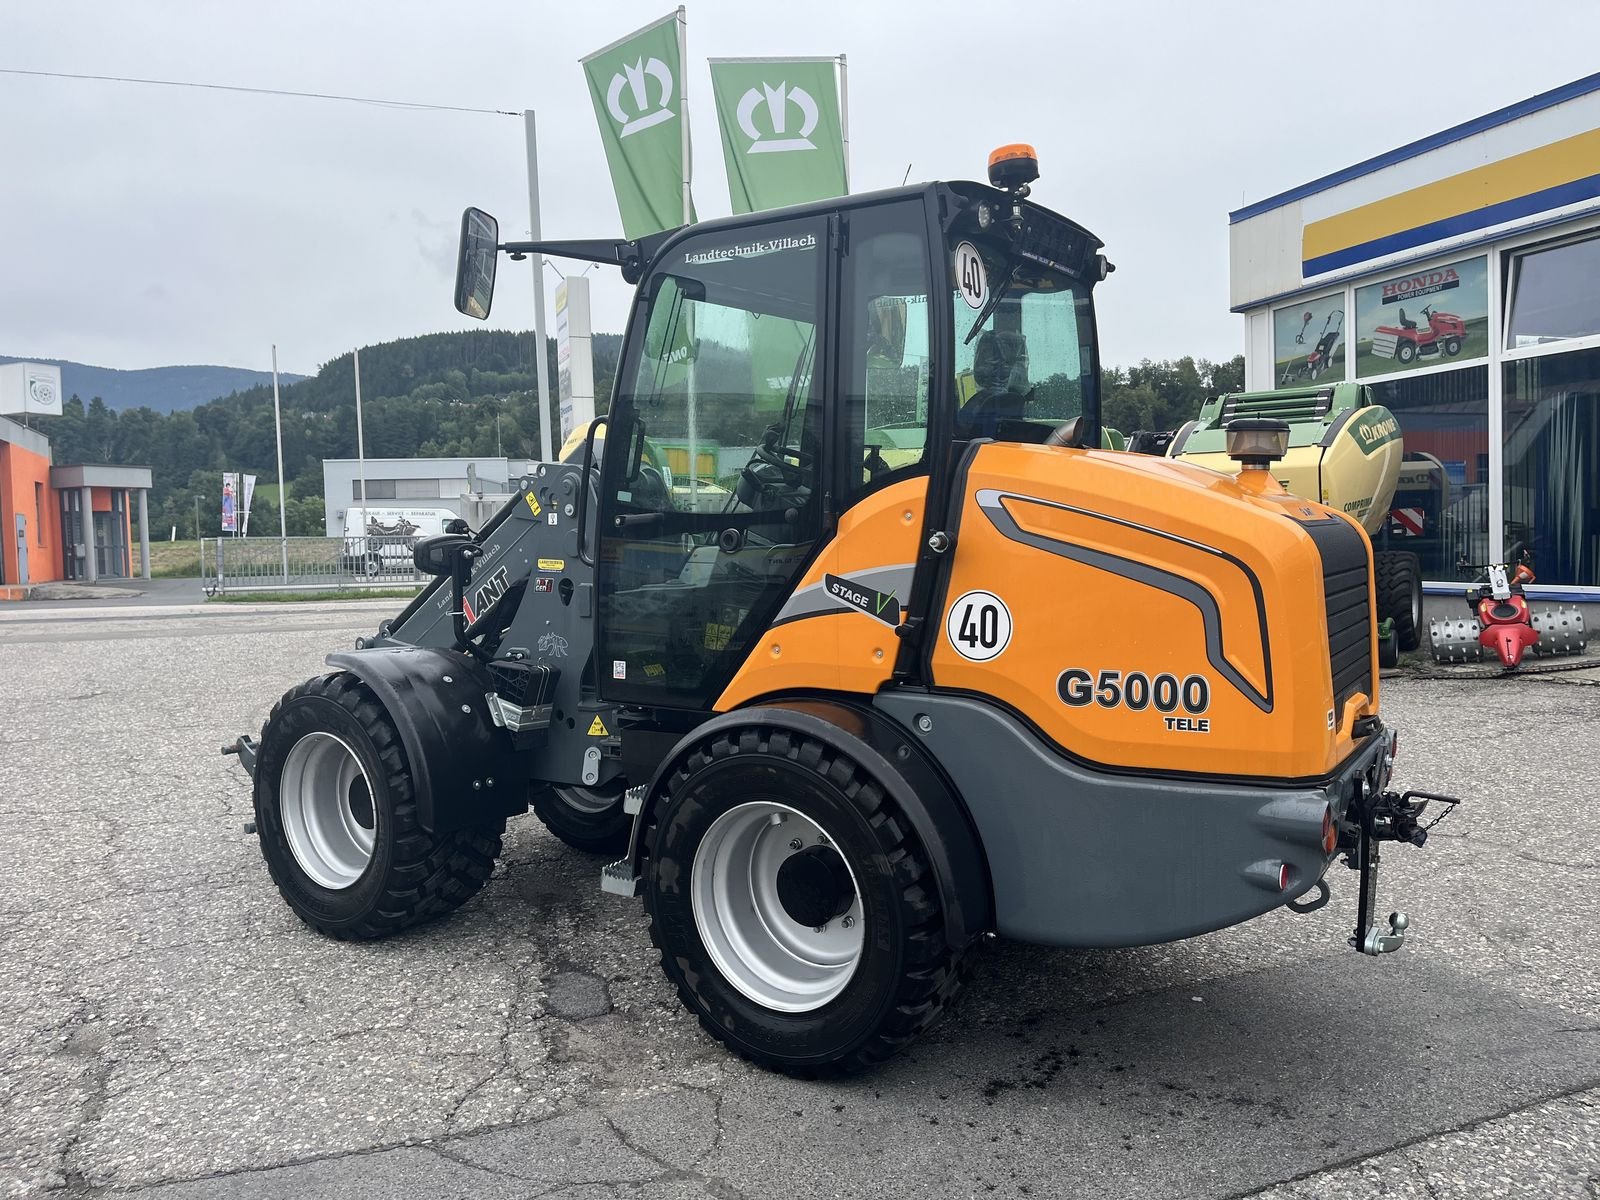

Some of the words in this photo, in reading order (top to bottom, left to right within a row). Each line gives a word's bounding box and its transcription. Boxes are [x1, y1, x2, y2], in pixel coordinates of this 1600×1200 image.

[684, 234, 817, 264] Landtechnik-Villach
[963, 253, 981, 299] 40
[1382, 268, 1460, 297] HONDA
[1397, 290, 1415, 301] POWER
[1415, 284, 1443, 297] EQUIPMENT
[1371, 418, 1396, 441] KRONE
[831, 583, 869, 608] STAGE
[877, 589, 897, 615] V
[958, 604, 998, 649] 40
[1056, 667, 1211, 715] G5000
[1164, 717, 1210, 733] TELE
